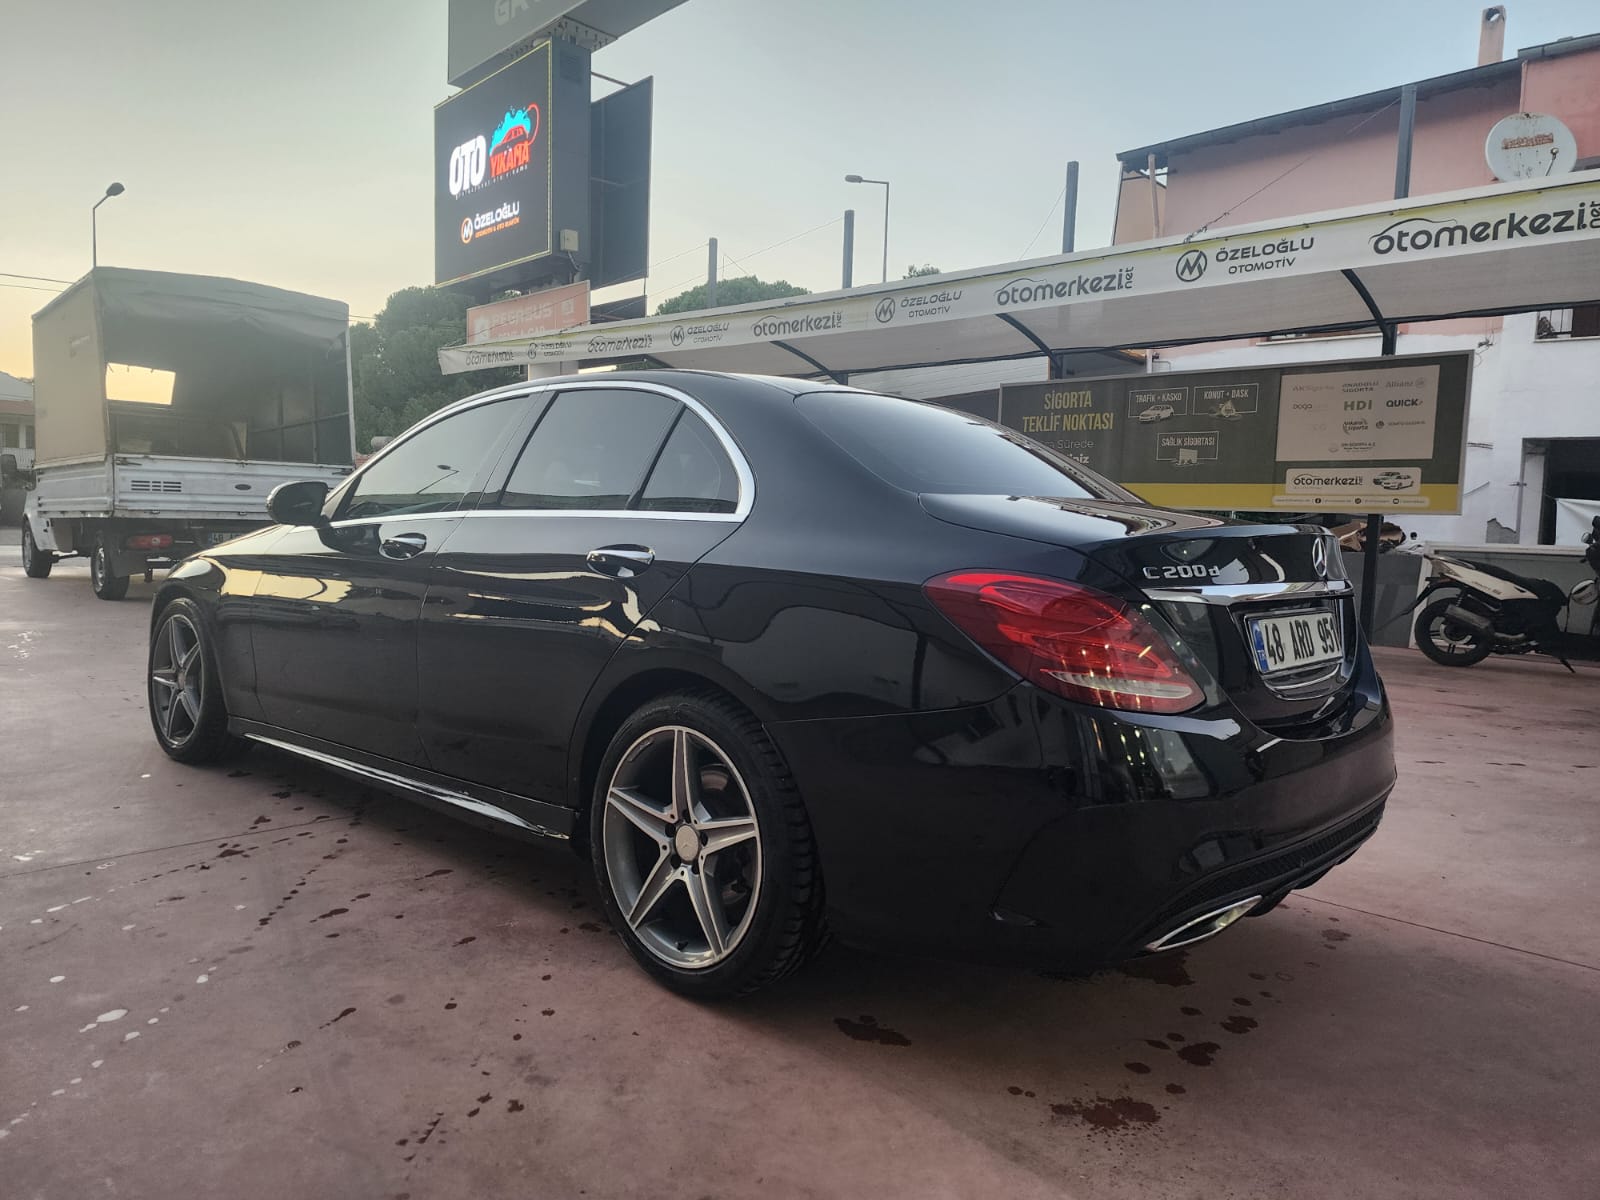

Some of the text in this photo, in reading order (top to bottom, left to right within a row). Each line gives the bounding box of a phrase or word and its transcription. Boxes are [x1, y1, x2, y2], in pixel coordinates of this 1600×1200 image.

[449, 135, 486, 195] OTO
[490, 140, 530, 178] YIKAMA
[474, 200, 520, 230] ÖZELOĞLU
[1215, 236, 1315, 263] ÖZELOĞLU
[1228, 256, 1297, 274] OTOMOTİV
[900, 290, 962, 308] ÖZELOĞLU
[908, 305, 951, 318] OTOMOTİV
[1044, 389, 1092, 410] SİGORTA
[1136, 392, 1182, 403] TRAFİK KASKO
[1204, 390, 1225, 400] KONUT
[1386, 399, 1419, 408] QUICK
[1343, 399, 1373, 411] HDI
[1022, 412, 1114, 432] TEKLİF NOKTASI
[1057, 439, 1094, 449] Sürede
[1183, 435, 1215, 446] SİGORTASI
[1293, 475, 1358, 486] otomerkezi
[1264, 617, 1340, 665] 48 ARD 951
